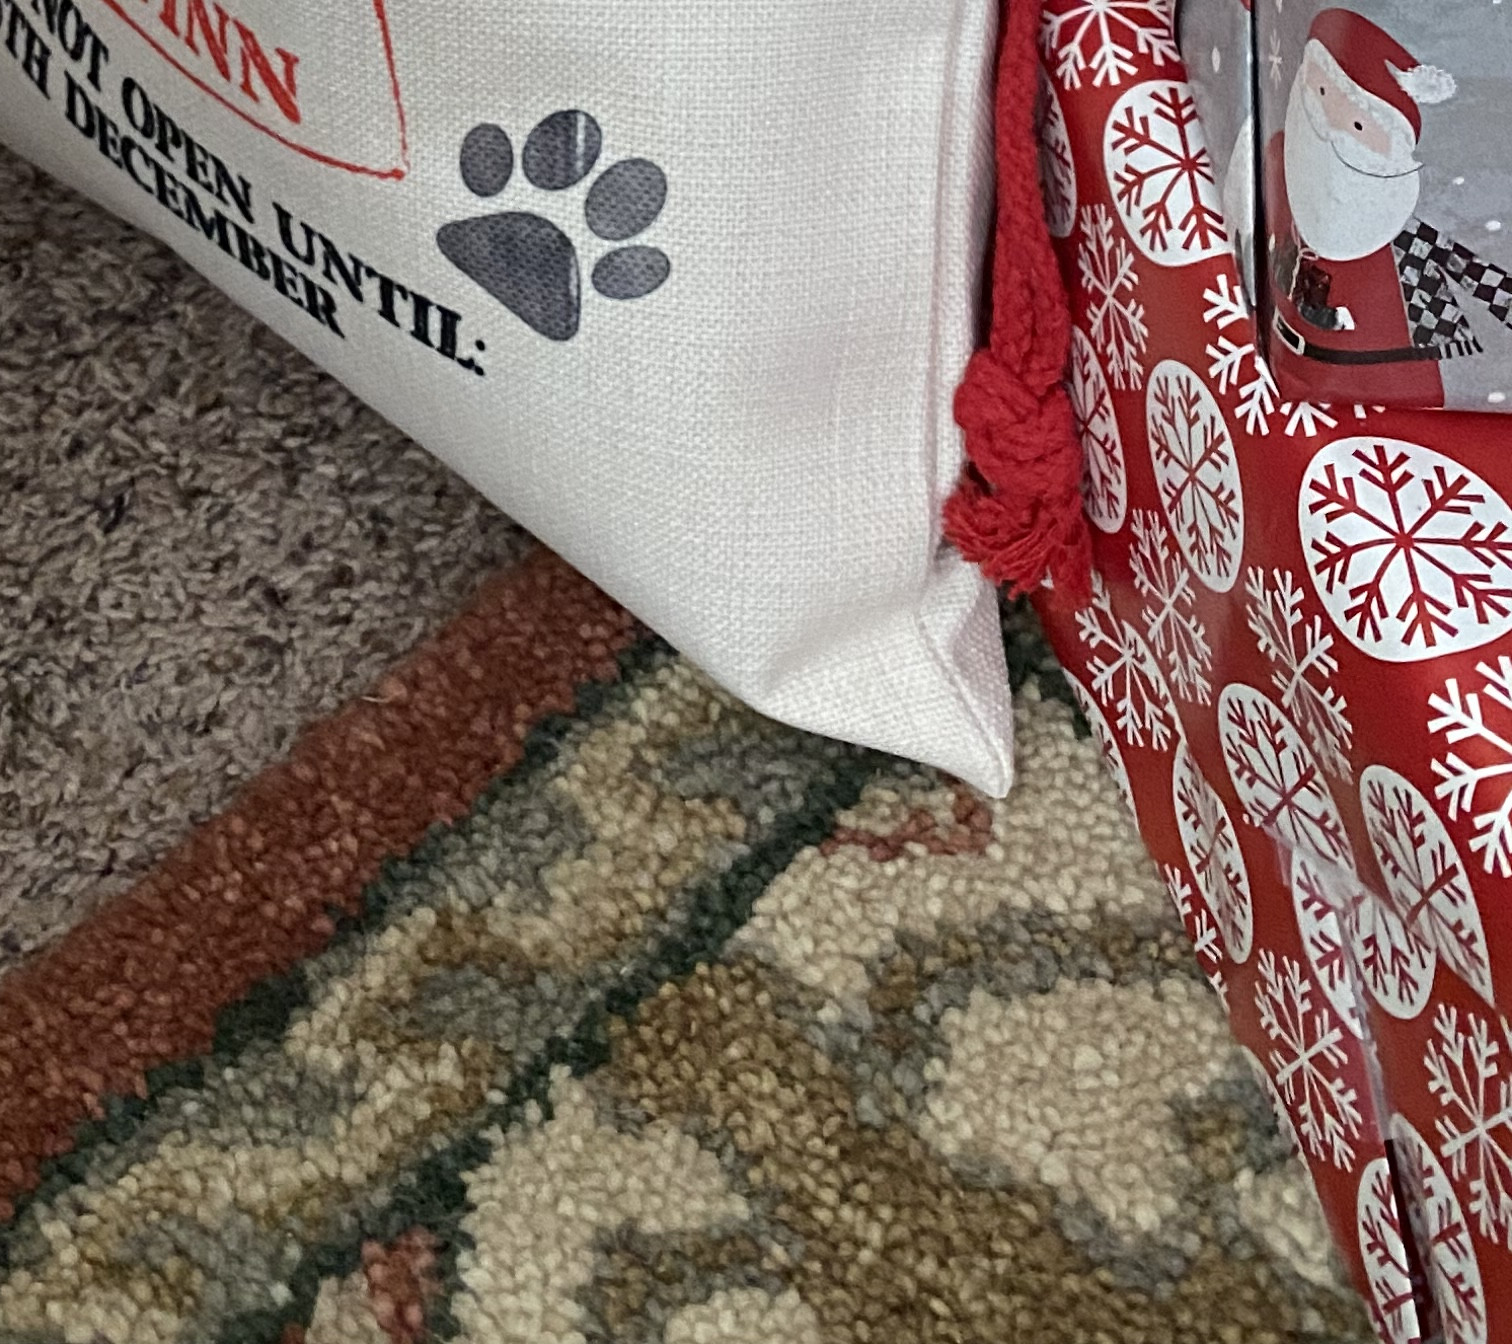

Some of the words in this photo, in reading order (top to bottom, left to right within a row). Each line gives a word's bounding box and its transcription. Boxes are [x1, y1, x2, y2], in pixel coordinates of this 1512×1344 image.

[64, 70, 346, 339] DECEMBER
[121, 76, 253, 224] OPEN
[272, 202, 487, 377] UNTIL:
